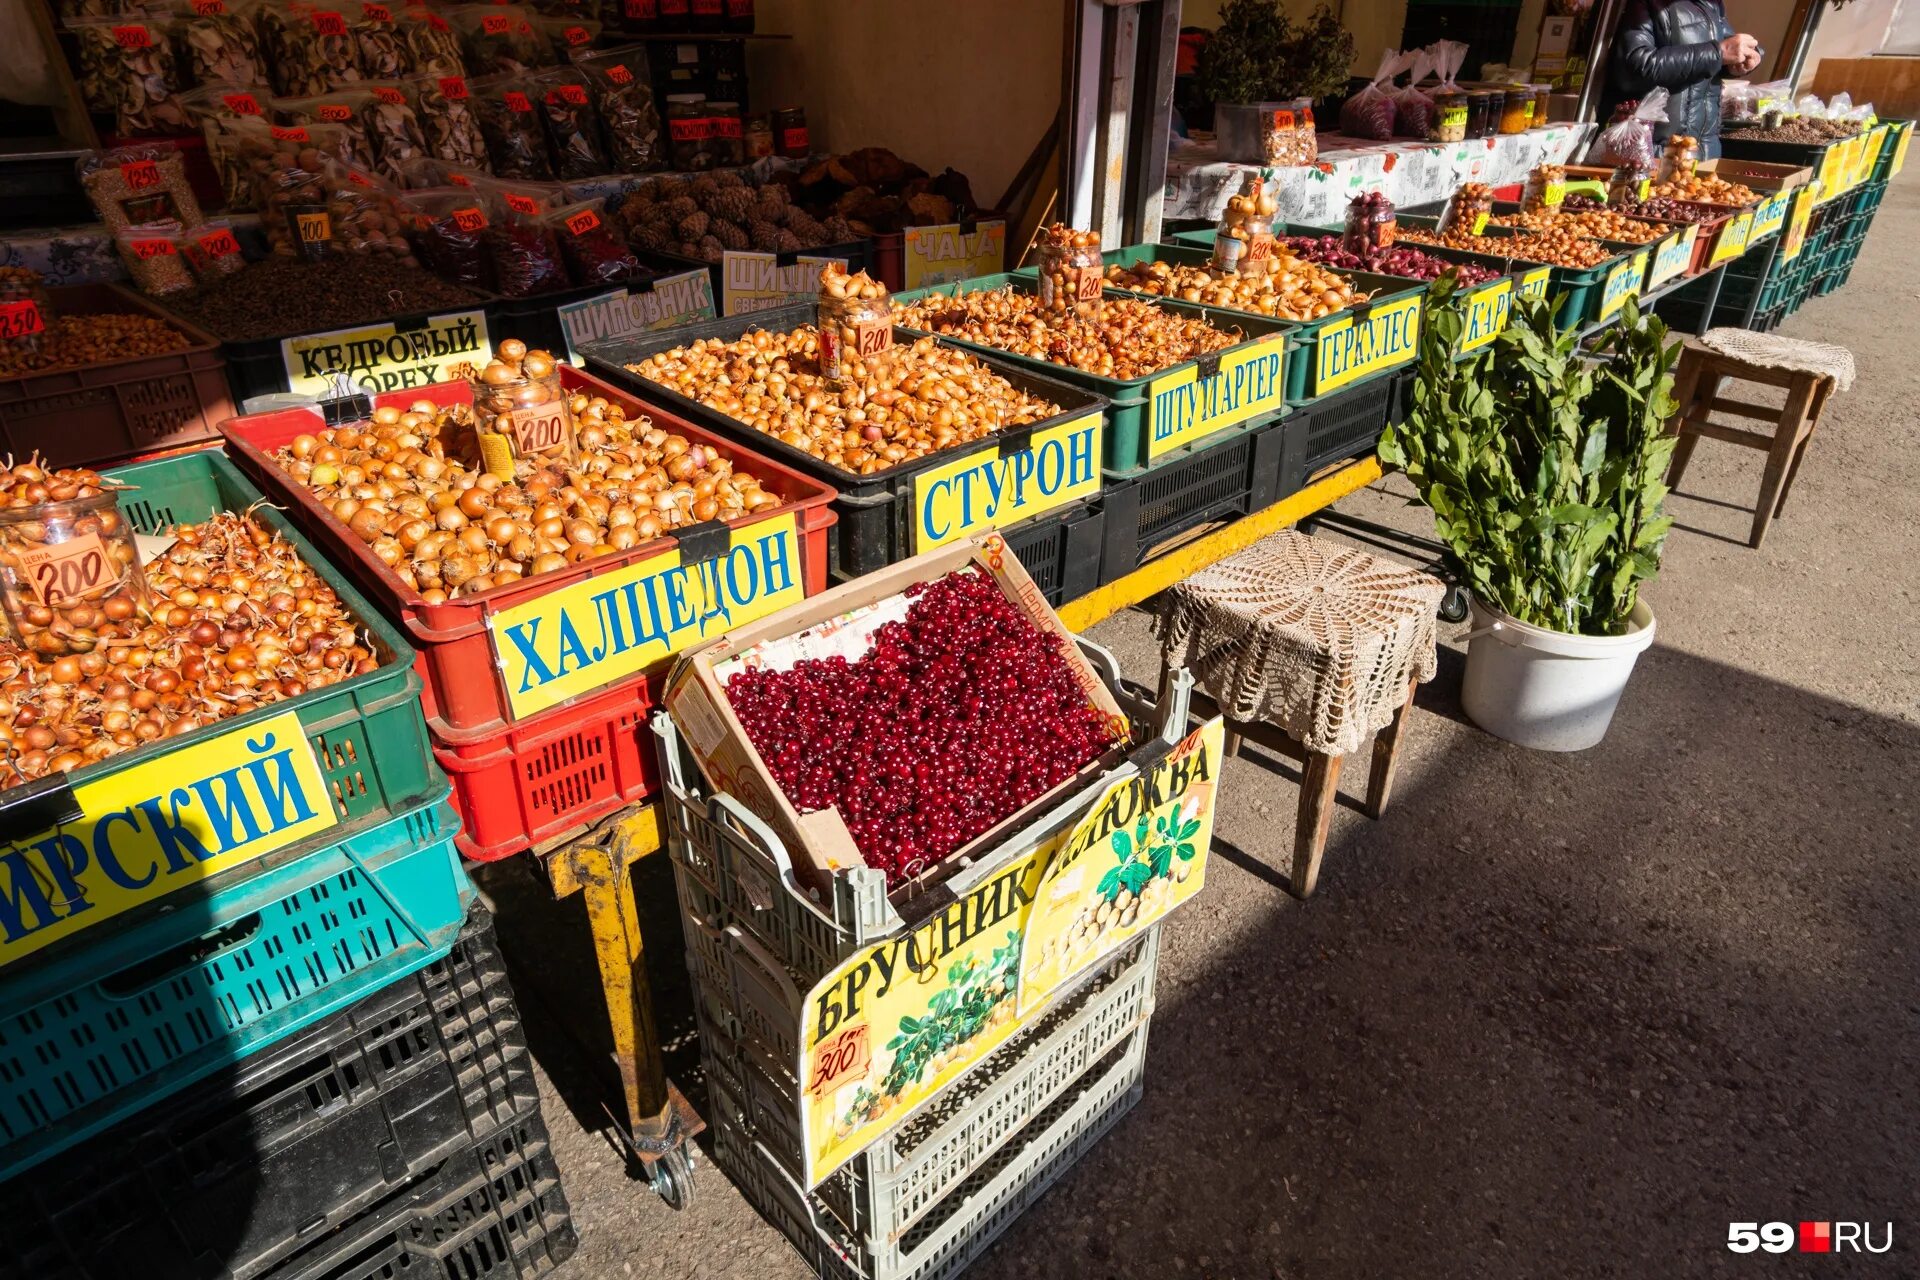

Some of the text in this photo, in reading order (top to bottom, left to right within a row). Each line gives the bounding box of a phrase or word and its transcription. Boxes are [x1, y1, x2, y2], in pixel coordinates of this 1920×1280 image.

[301, 221, 323, 240] 100
[458, 214, 482, 229] 250
[728, 256, 824, 293] ШИШК
[0, 308, 36, 338] 250
[566, 276, 709, 346] ШИПОВНИК
[298, 316, 481, 379] КЕДРОВЫЙ
[863, 328, 889, 357] 200
[1320, 306, 1417, 382] ГЕРКУЛЕС
[521, 416, 561, 452] 200
[923, 427, 1096, 541] СТУРОН
[23, 552, 51, 565] ЦЕНА
[37, 551, 102, 607] 200
[504, 530, 795, 694] ХАЛЦЕДОН
[811, 1041, 857, 1091] 300
